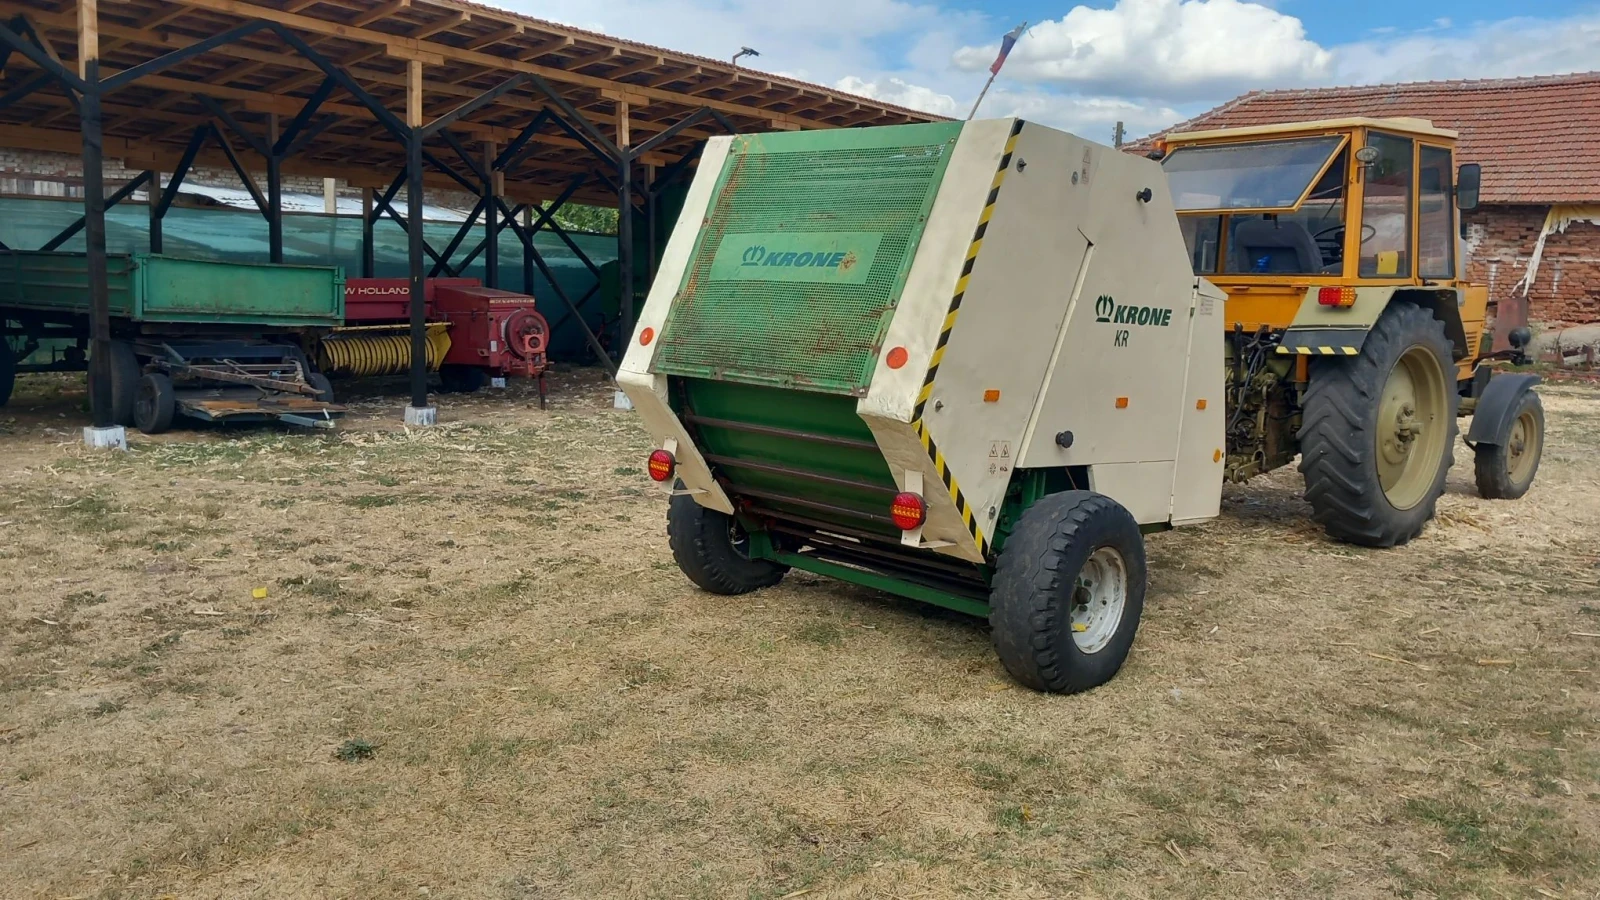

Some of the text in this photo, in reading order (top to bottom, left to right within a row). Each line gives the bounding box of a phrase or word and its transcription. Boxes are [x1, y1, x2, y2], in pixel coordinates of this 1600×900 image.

[762, 251, 846, 268] KRONE
[358, 287, 409, 295] HOLLAND
[1113, 304, 1172, 327] KRONE
[1114, 329, 1130, 347] KR
